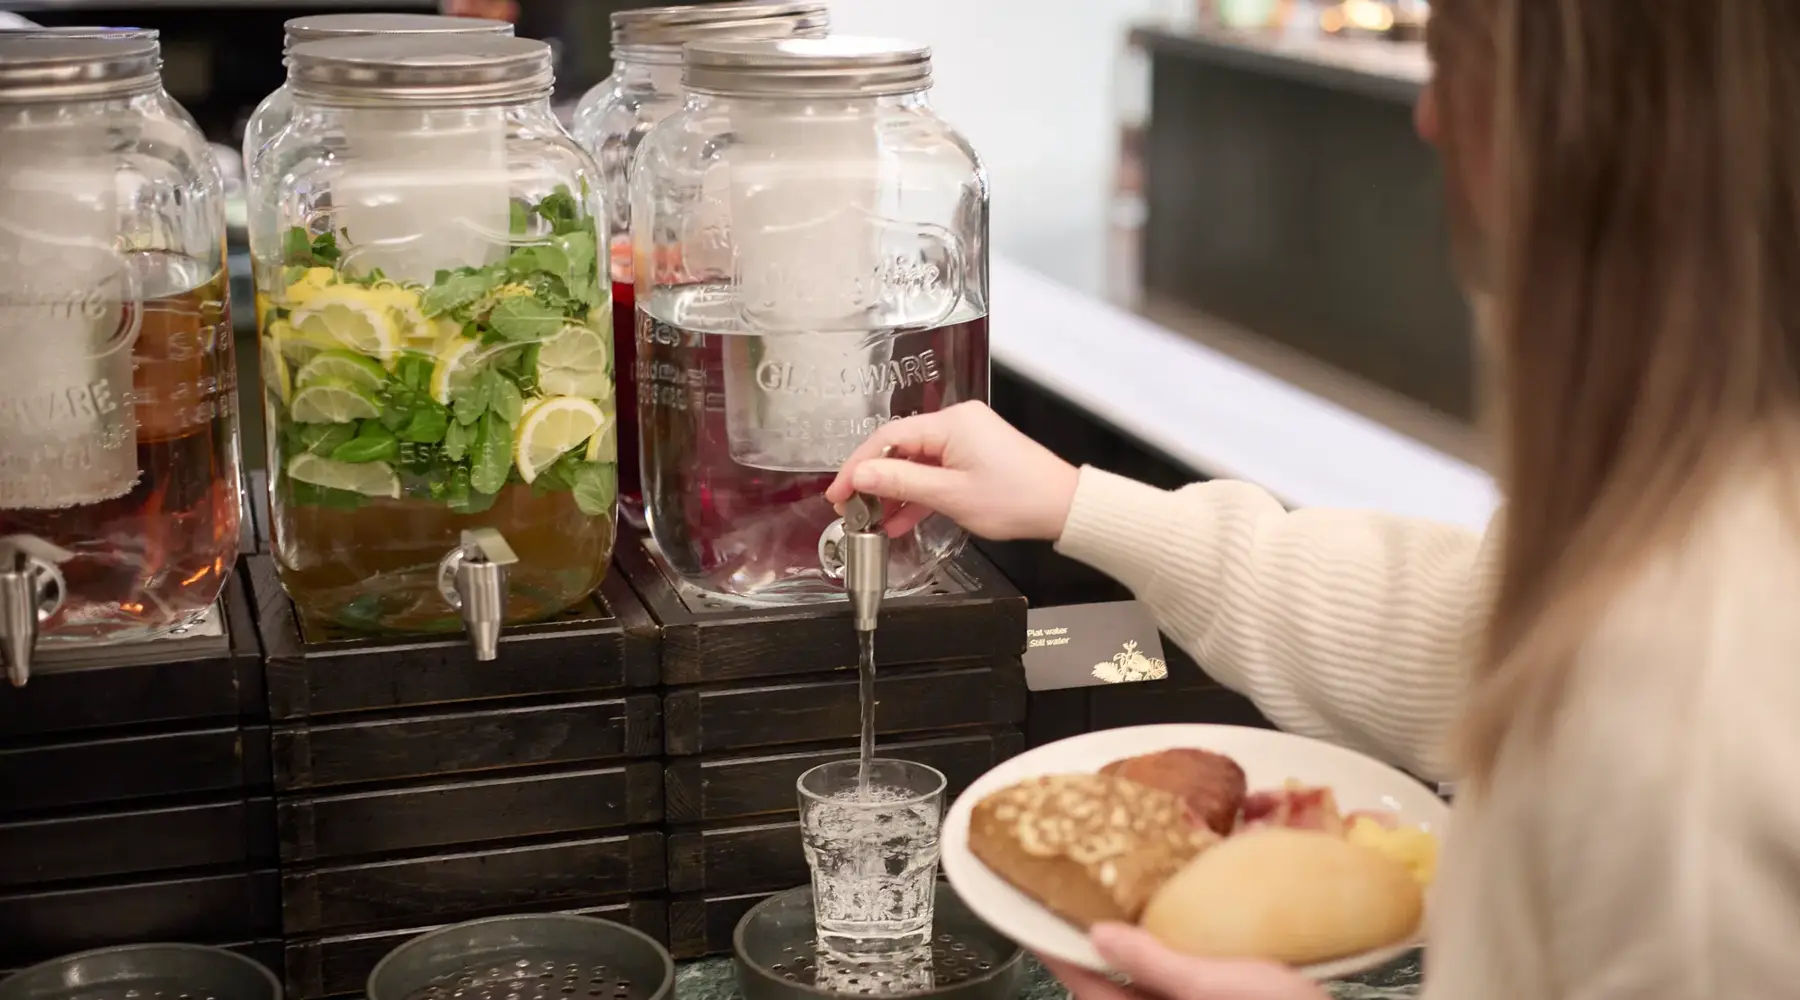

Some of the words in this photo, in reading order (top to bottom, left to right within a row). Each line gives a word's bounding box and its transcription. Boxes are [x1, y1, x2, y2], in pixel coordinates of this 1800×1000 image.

[1026, 629, 1044, 637] Plat
[1044, 626, 1068, 635] water
[1029, 638, 1045, 647] Still
[1046, 637, 1070, 646] water
